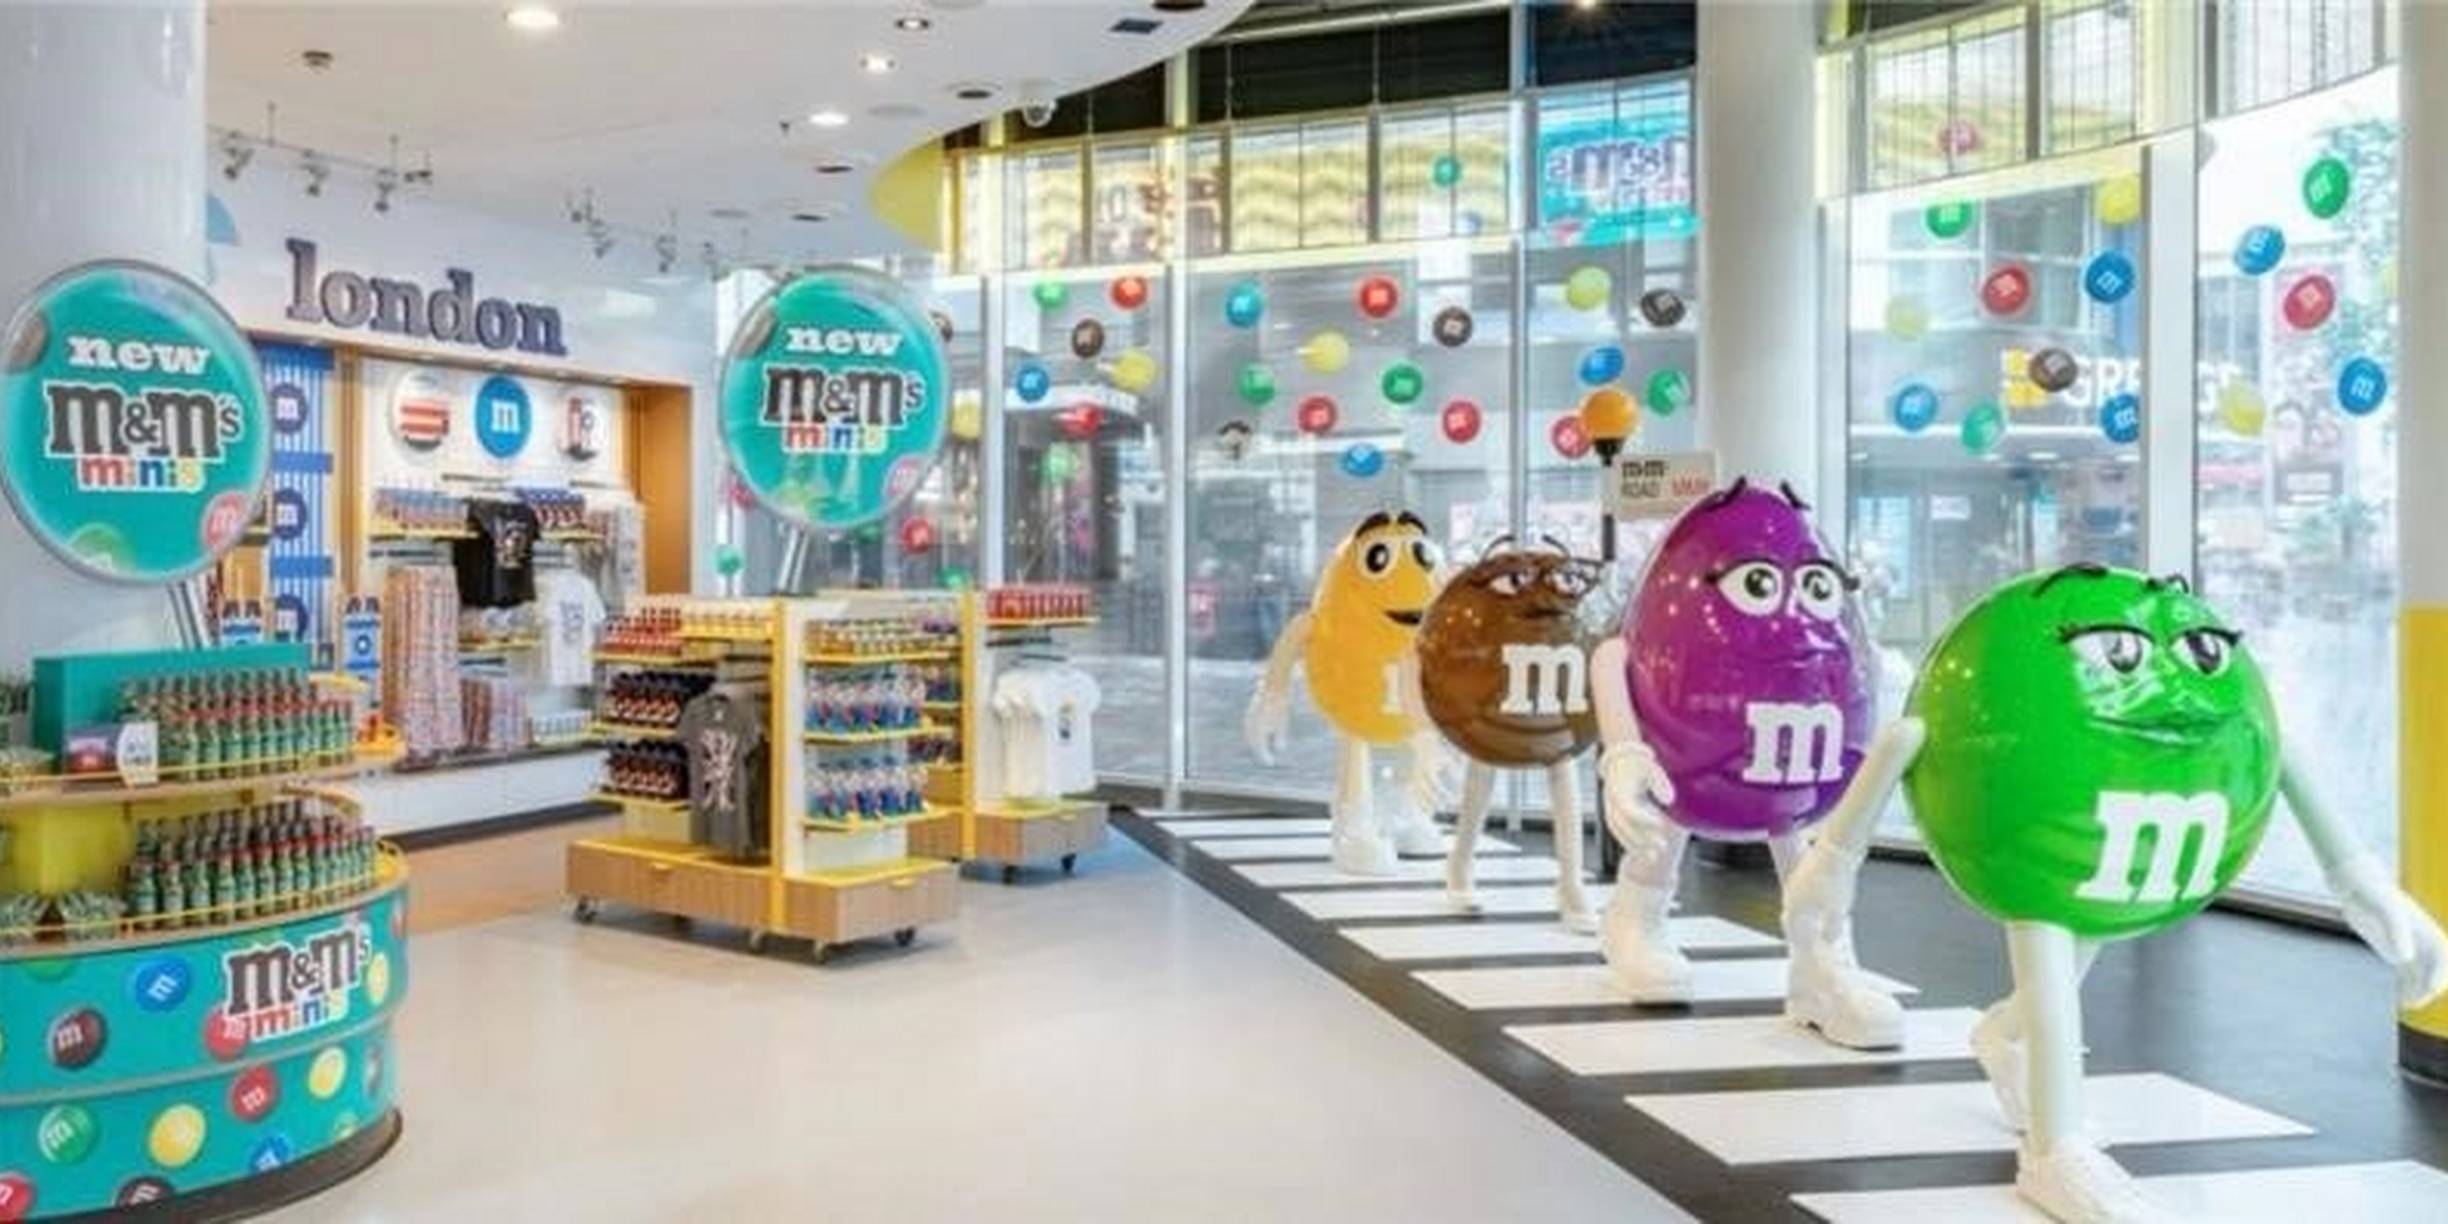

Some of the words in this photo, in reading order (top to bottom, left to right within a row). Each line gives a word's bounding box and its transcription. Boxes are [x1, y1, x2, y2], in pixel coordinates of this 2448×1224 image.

[285, 237, 568, 357] london
[67, 335, 211, 375] new
[786, 325, 903, 357] new
[491, 401, 521, 434] m
[81, 456, 204, 492] minis
[1501, 643, 1589, 715] m
[1741, 700, 1845, 784] m
[2074, 789, 2230, 903] m
[57, 1021, 84, 1049] m
[240, 1086, 266, 1112] m
